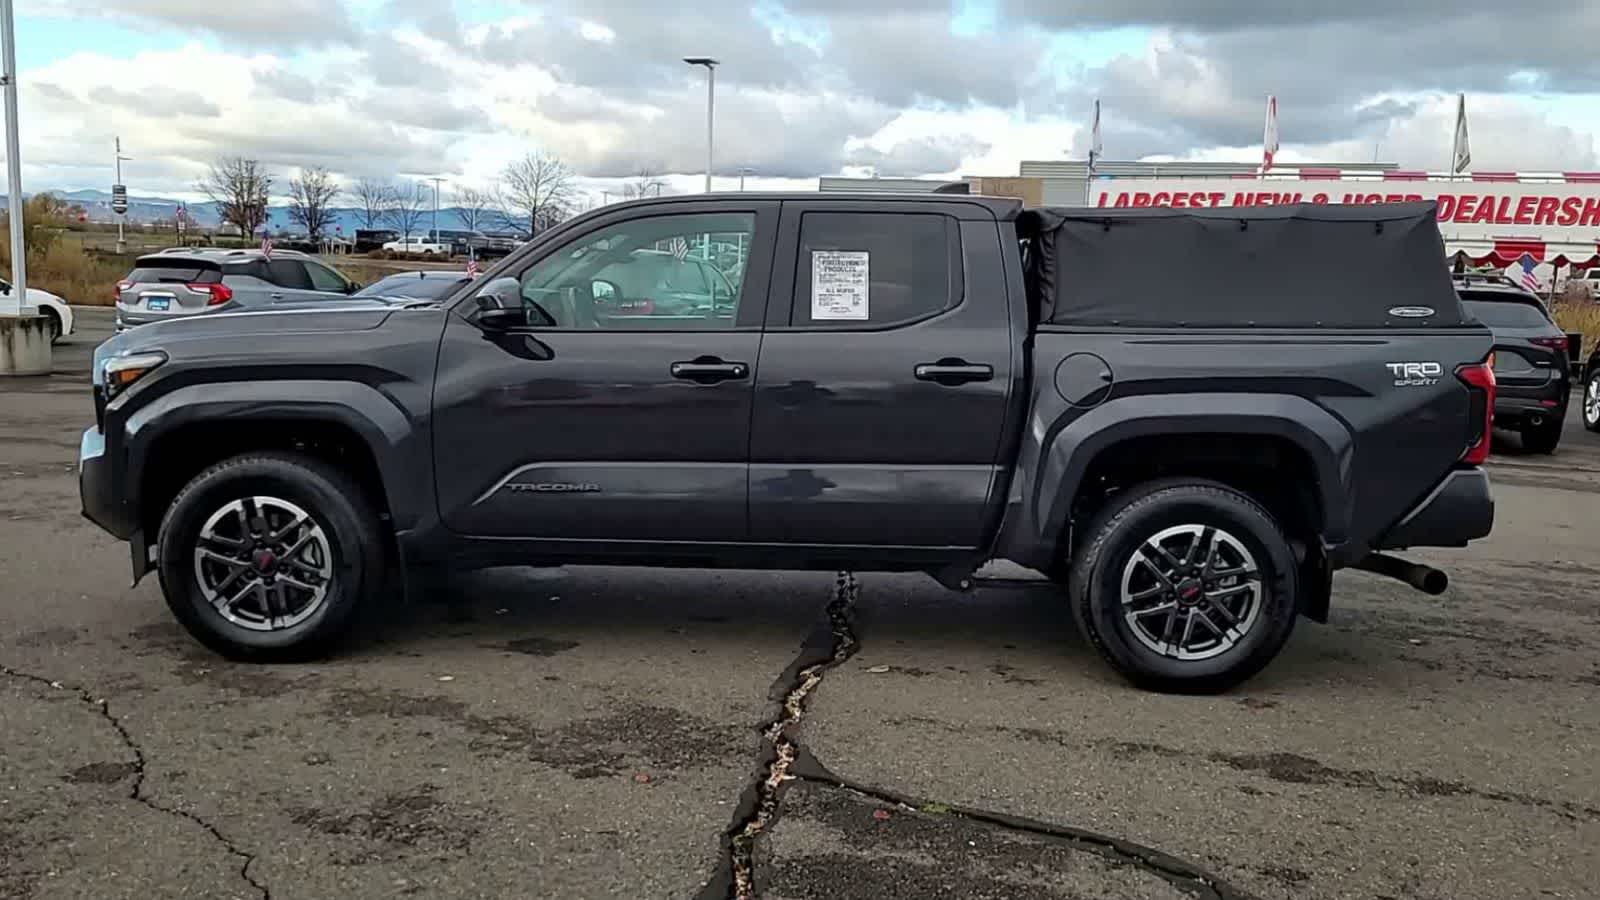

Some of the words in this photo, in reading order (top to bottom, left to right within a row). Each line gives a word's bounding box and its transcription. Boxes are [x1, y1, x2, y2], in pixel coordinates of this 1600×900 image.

[1436, 194, 1600, 227] DEALERSH
[1385, 362, 1441, 378] TRD
[505, 482, 600, 492] TACOMA
